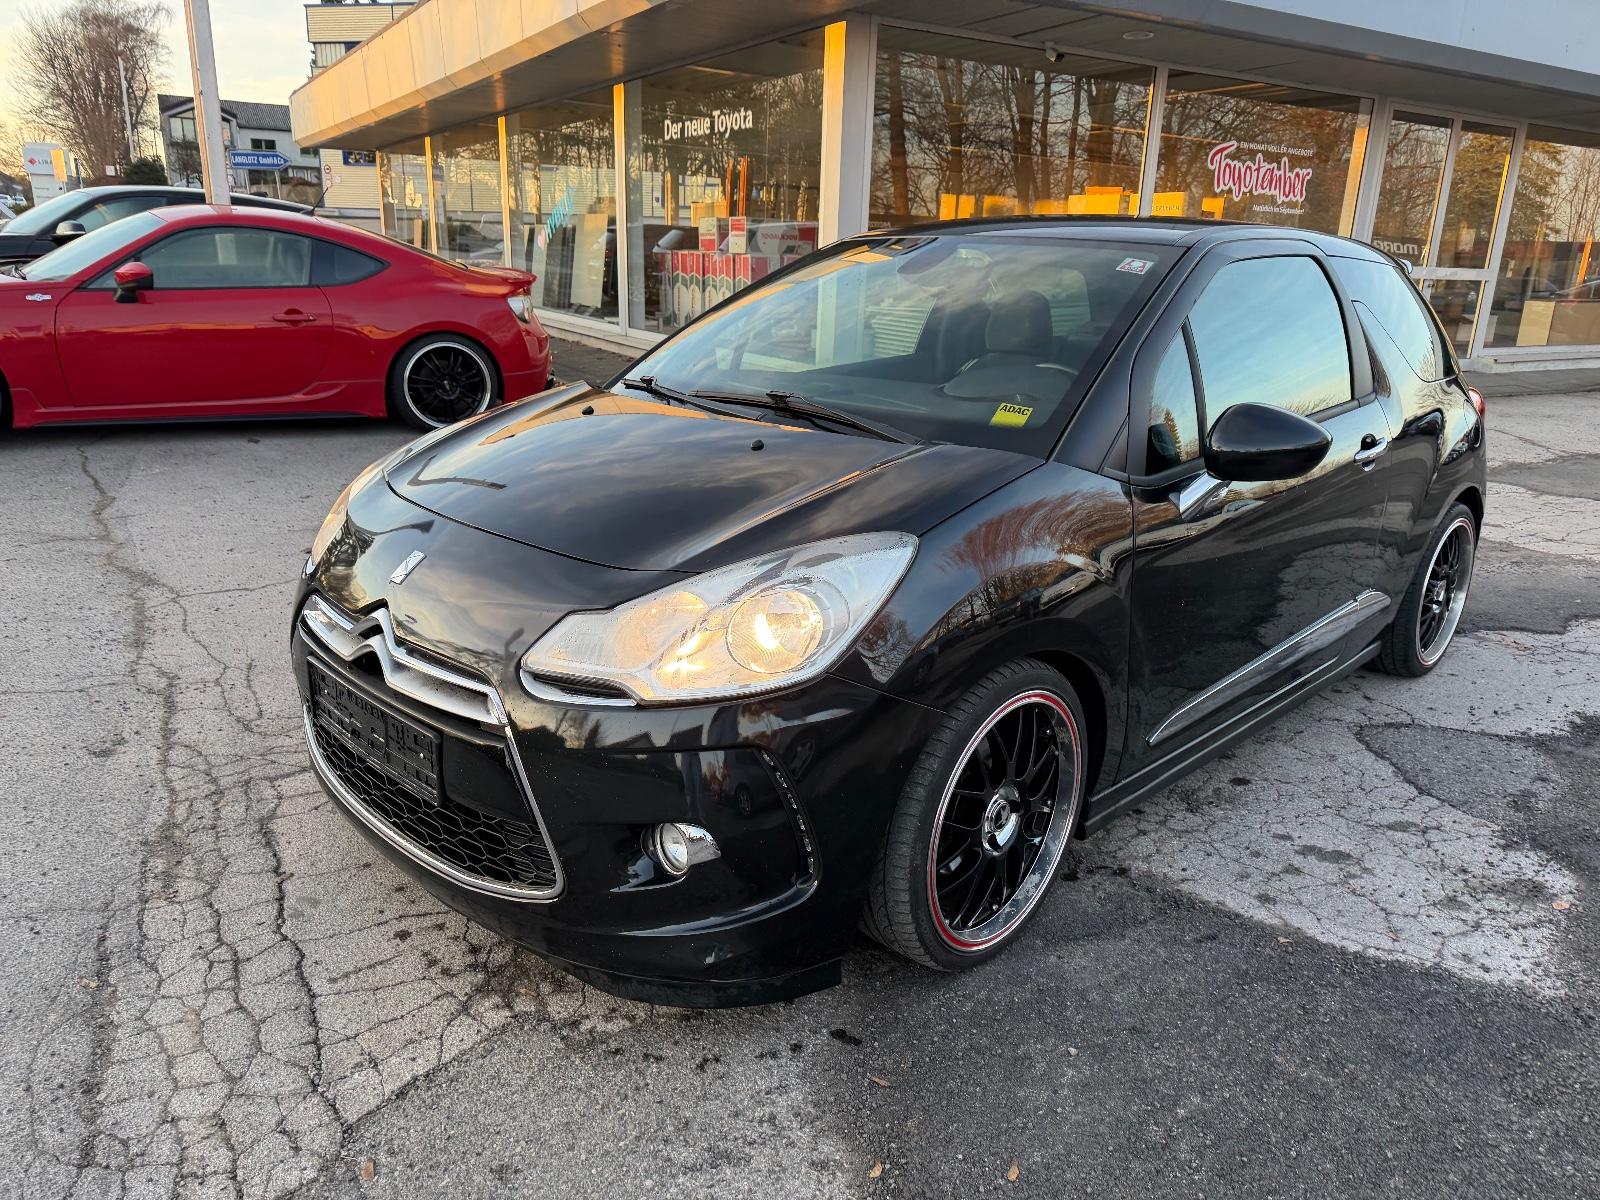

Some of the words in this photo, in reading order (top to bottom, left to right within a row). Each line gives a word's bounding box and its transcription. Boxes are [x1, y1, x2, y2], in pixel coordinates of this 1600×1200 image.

[664, 119, 682, 141] Der
[684, 117, 711, 138] neue
[712, 106, 753, 139] Toyota
[1240, 141, 1249, 149] EIN
[1250, 142, 1268, 151] MONAT
[1288, 147, 1314, 157] ANGEBOTE
[231, 155, 258, 164] LANGLOTZ
[1208, 141, 1312, 203] Toyotember
[1253, 204, 1274, 213] Natürlich
[1000, 404, 1030, 416] ADAC
